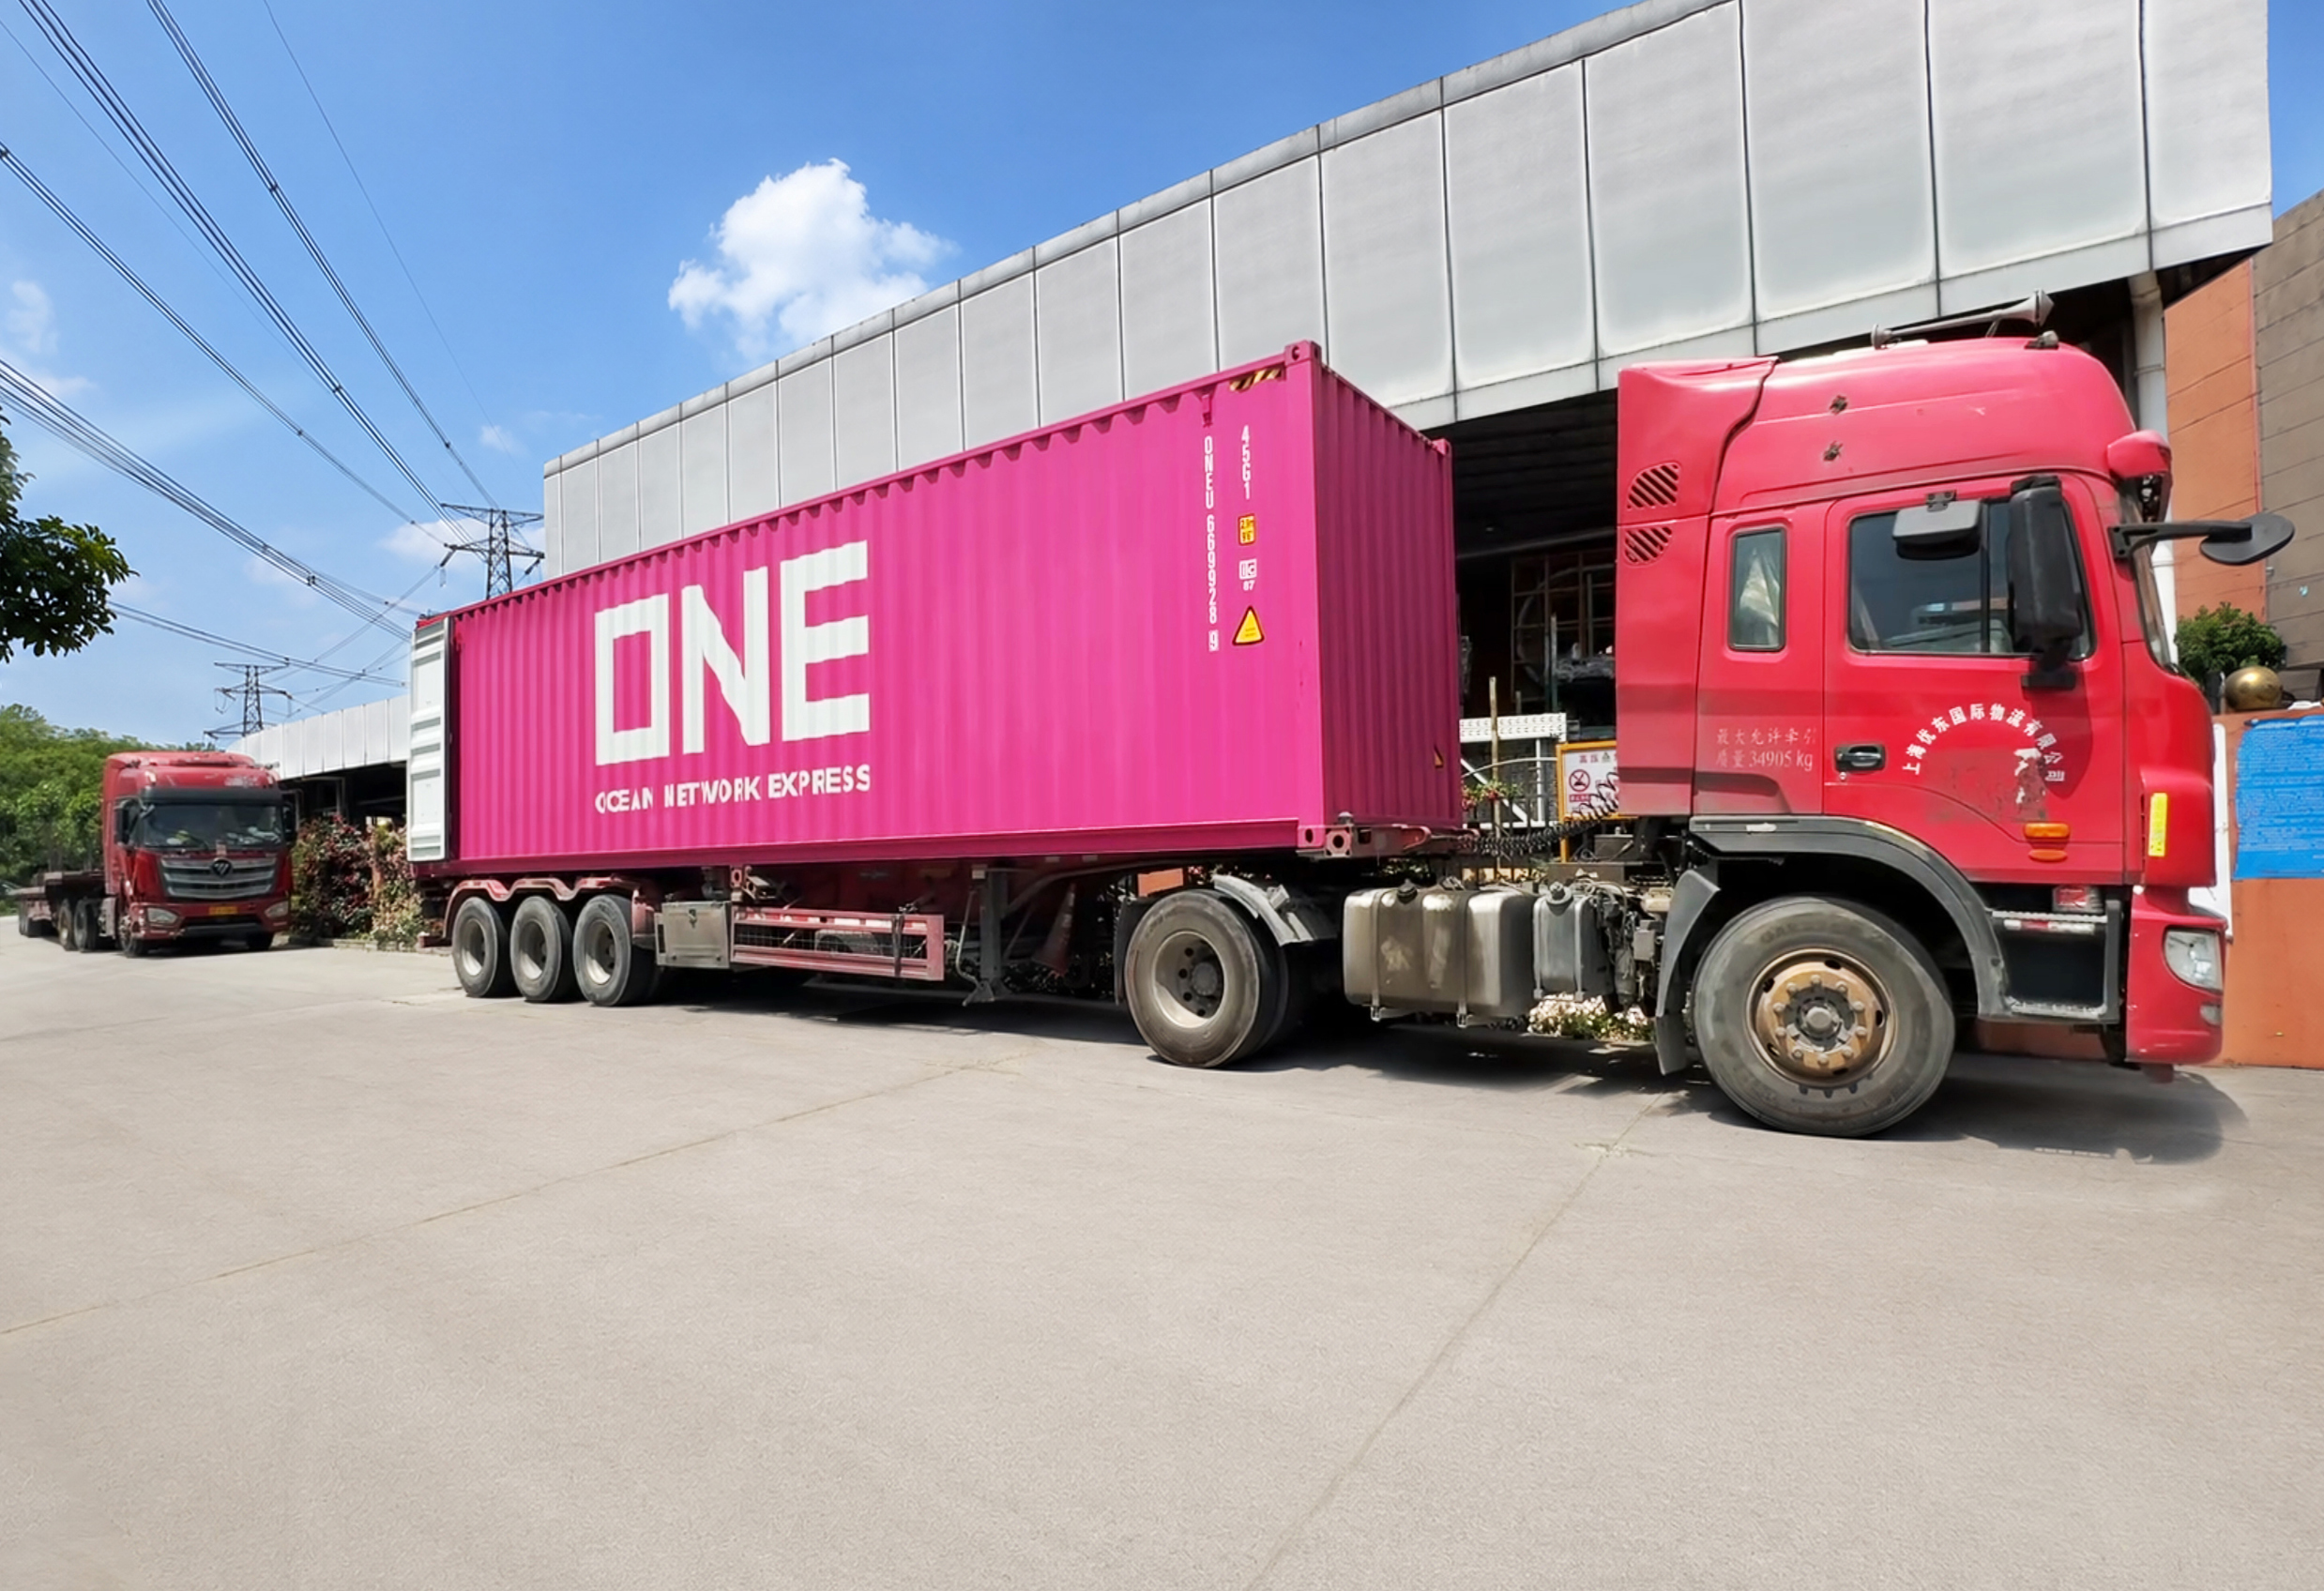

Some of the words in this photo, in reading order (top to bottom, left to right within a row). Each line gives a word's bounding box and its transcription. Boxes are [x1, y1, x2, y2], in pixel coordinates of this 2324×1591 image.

[1204, 435, 1214, 509] ONEU
[1241, 425, 1251, 500] 45G1
[1207, 514, 1218, 625] 669928
[595, 539, 871, 765] ONE
[595, 786, 654, 814] OCEAN
[664, 776, 762, 809] NETWORK
[767, 764, 871, 799] EXPRESS
